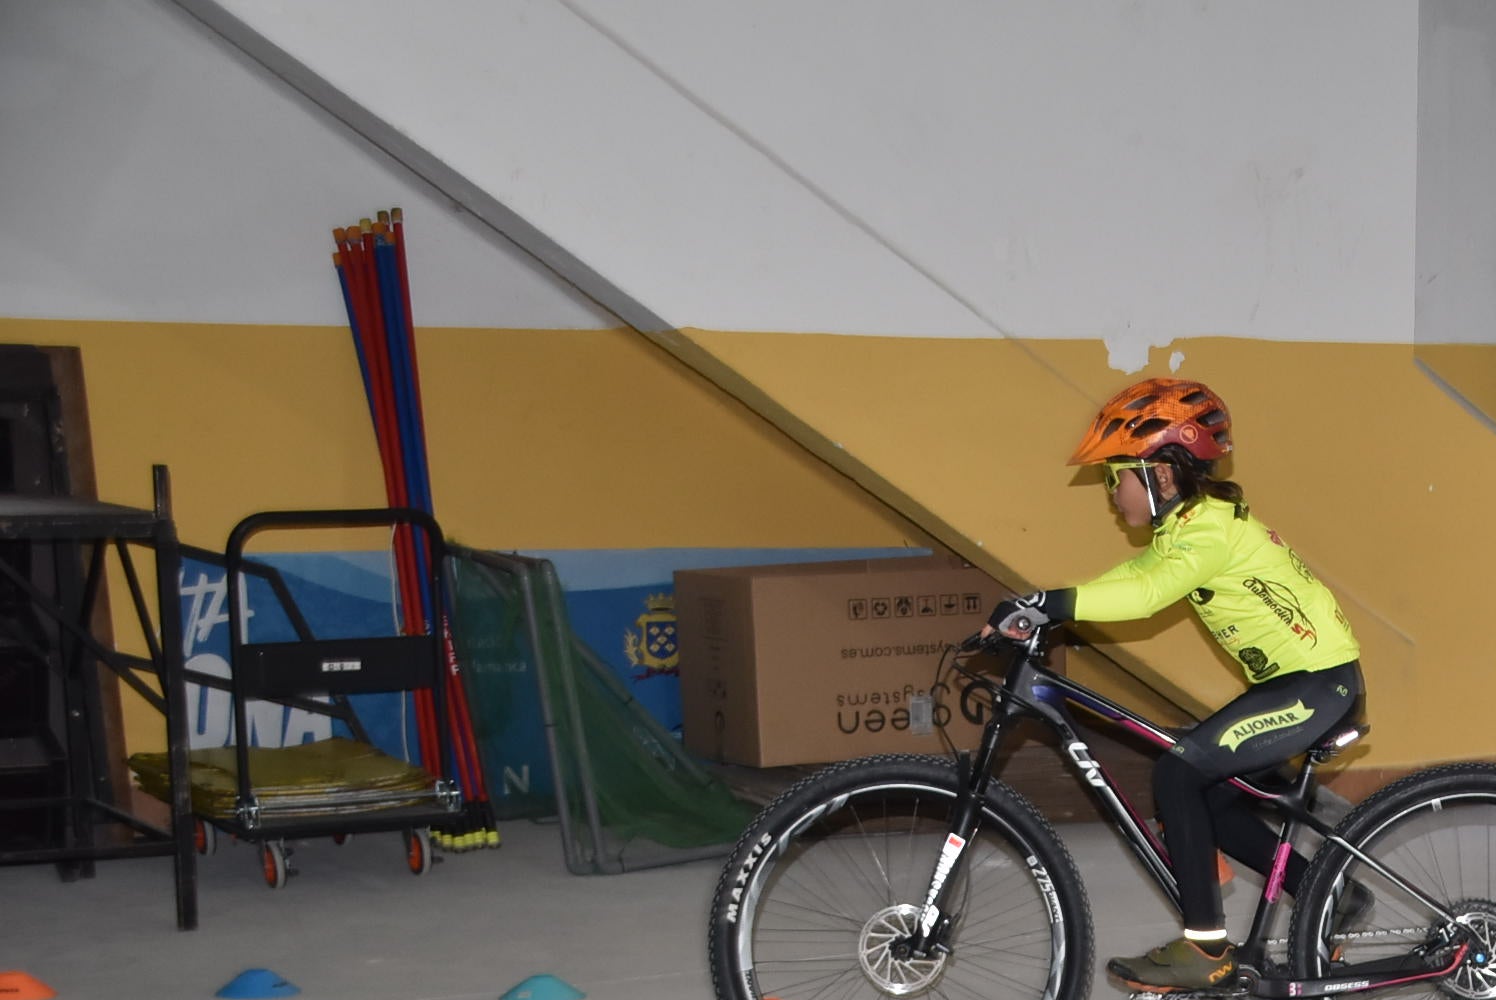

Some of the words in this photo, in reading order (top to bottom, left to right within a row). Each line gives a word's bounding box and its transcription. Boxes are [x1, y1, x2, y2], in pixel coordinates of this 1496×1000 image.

[1231, 711, 1298, 741] ALJOMAR
[727, 831, 772, 924] MAXXIS
[1324, 979, 1370, 992] OBSESS
